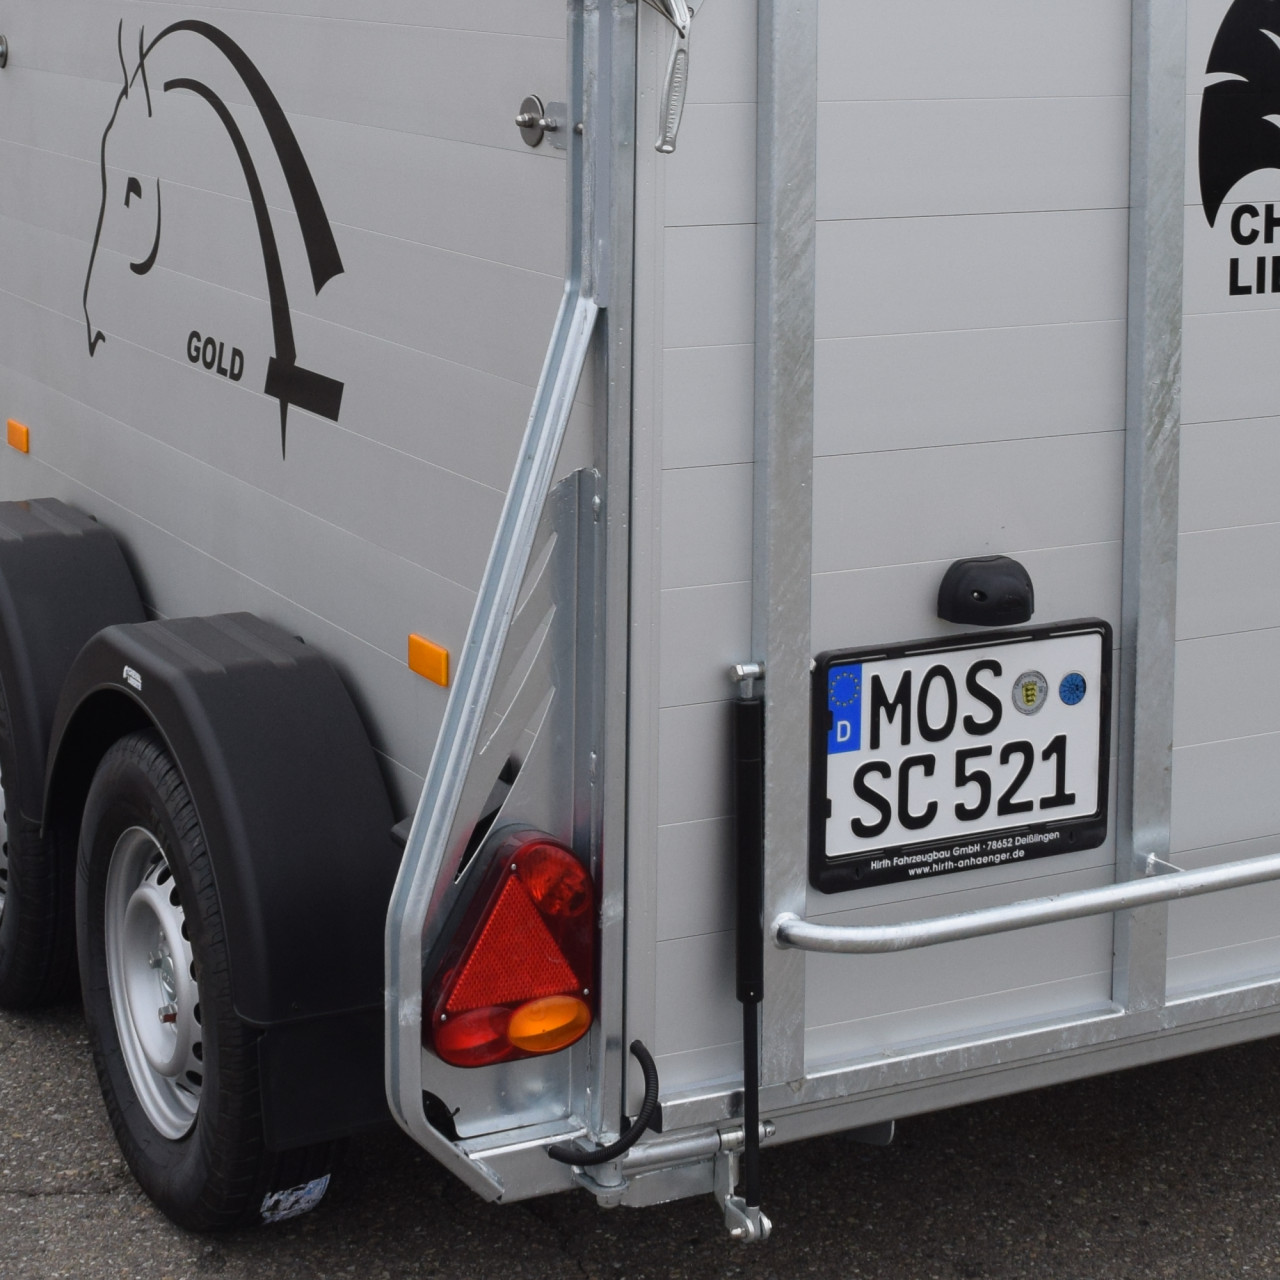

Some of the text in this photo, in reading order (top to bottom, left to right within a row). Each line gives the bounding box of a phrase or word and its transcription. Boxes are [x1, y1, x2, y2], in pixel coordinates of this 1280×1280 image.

[187, 330, 244, 382] GOLD
[869, 659, 1003, 750] MOS
[836, 720, 851, 743] D
[850, 734, 1076, 838] SC 521
[871, 831, 1060, 870] Hirth Fahrzeugbau GmbH 78652 Deißlingen
[908, 849, 1025, 876] www.hirth-anhaenger.de
